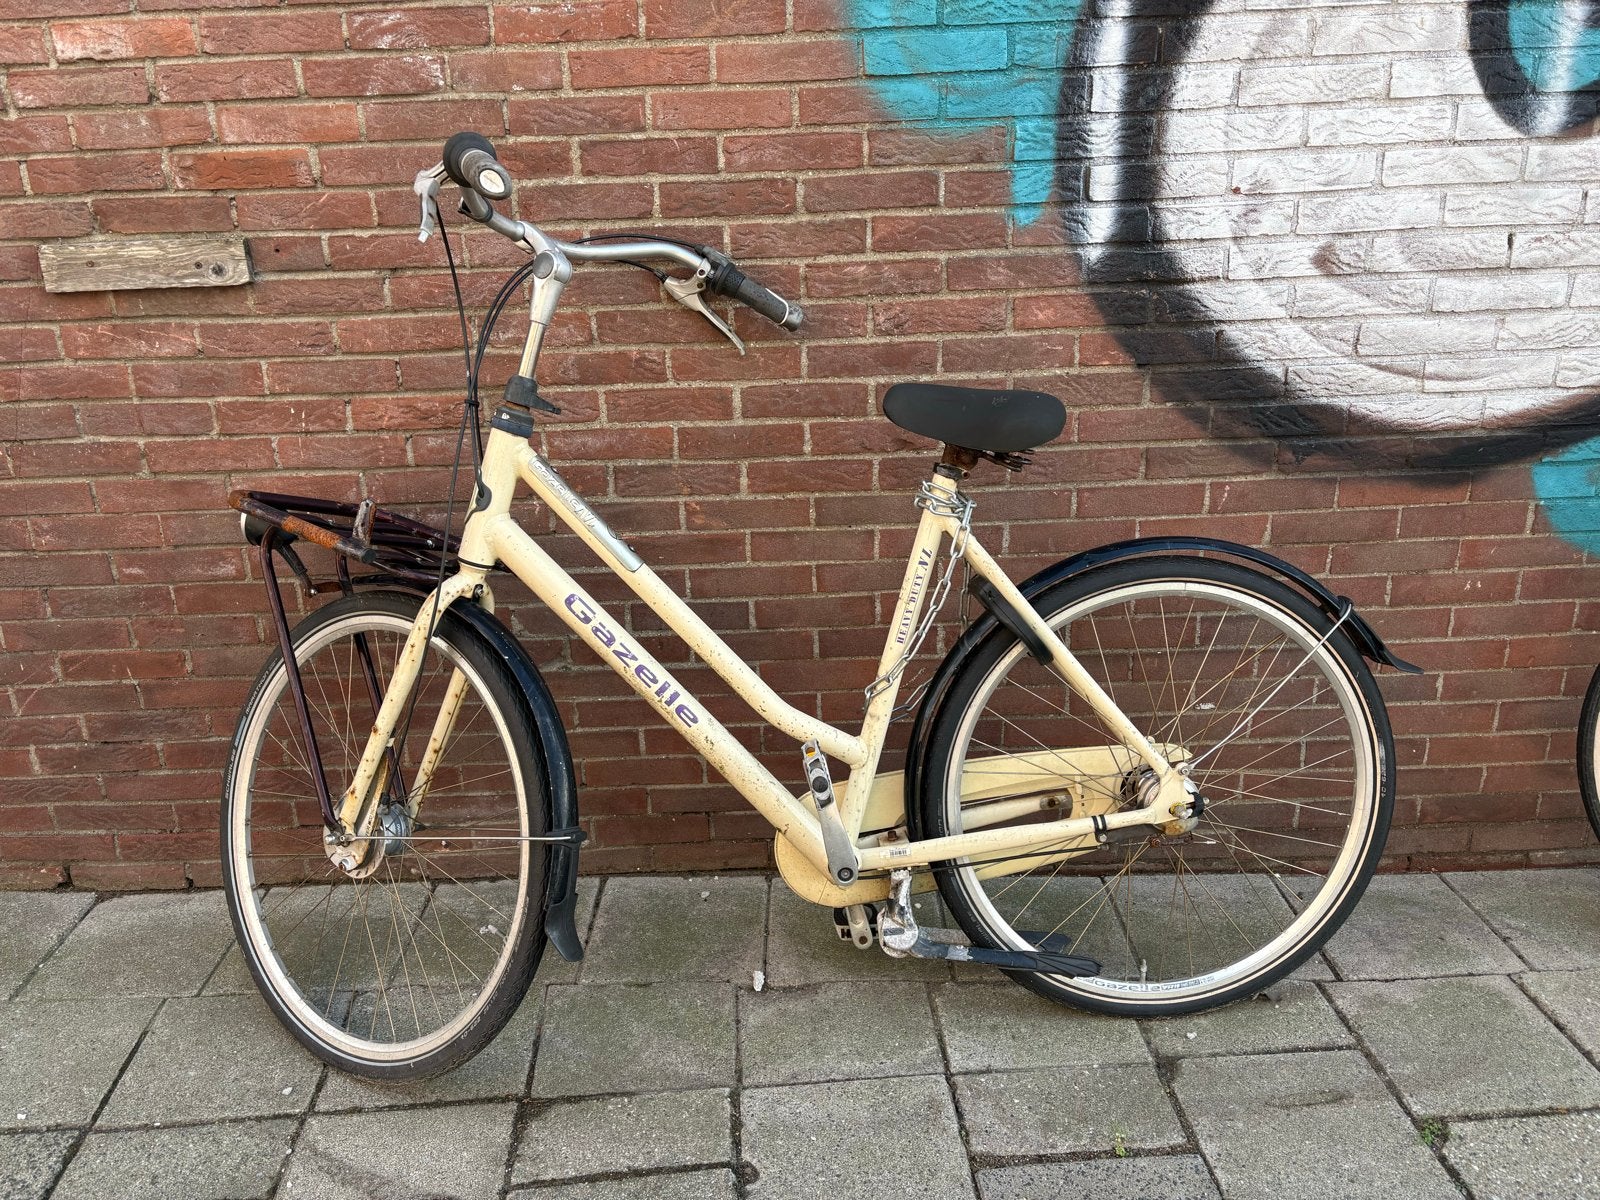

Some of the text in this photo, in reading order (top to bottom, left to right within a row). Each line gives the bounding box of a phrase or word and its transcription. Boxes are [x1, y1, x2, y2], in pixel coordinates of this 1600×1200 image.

[896, 608, 913, 644] HEAVY
[909, 574, 922, 602] DUTY
[564, 593, 699, 728] Gazelle
[1094, 979, 1161, 992] Gazelle
